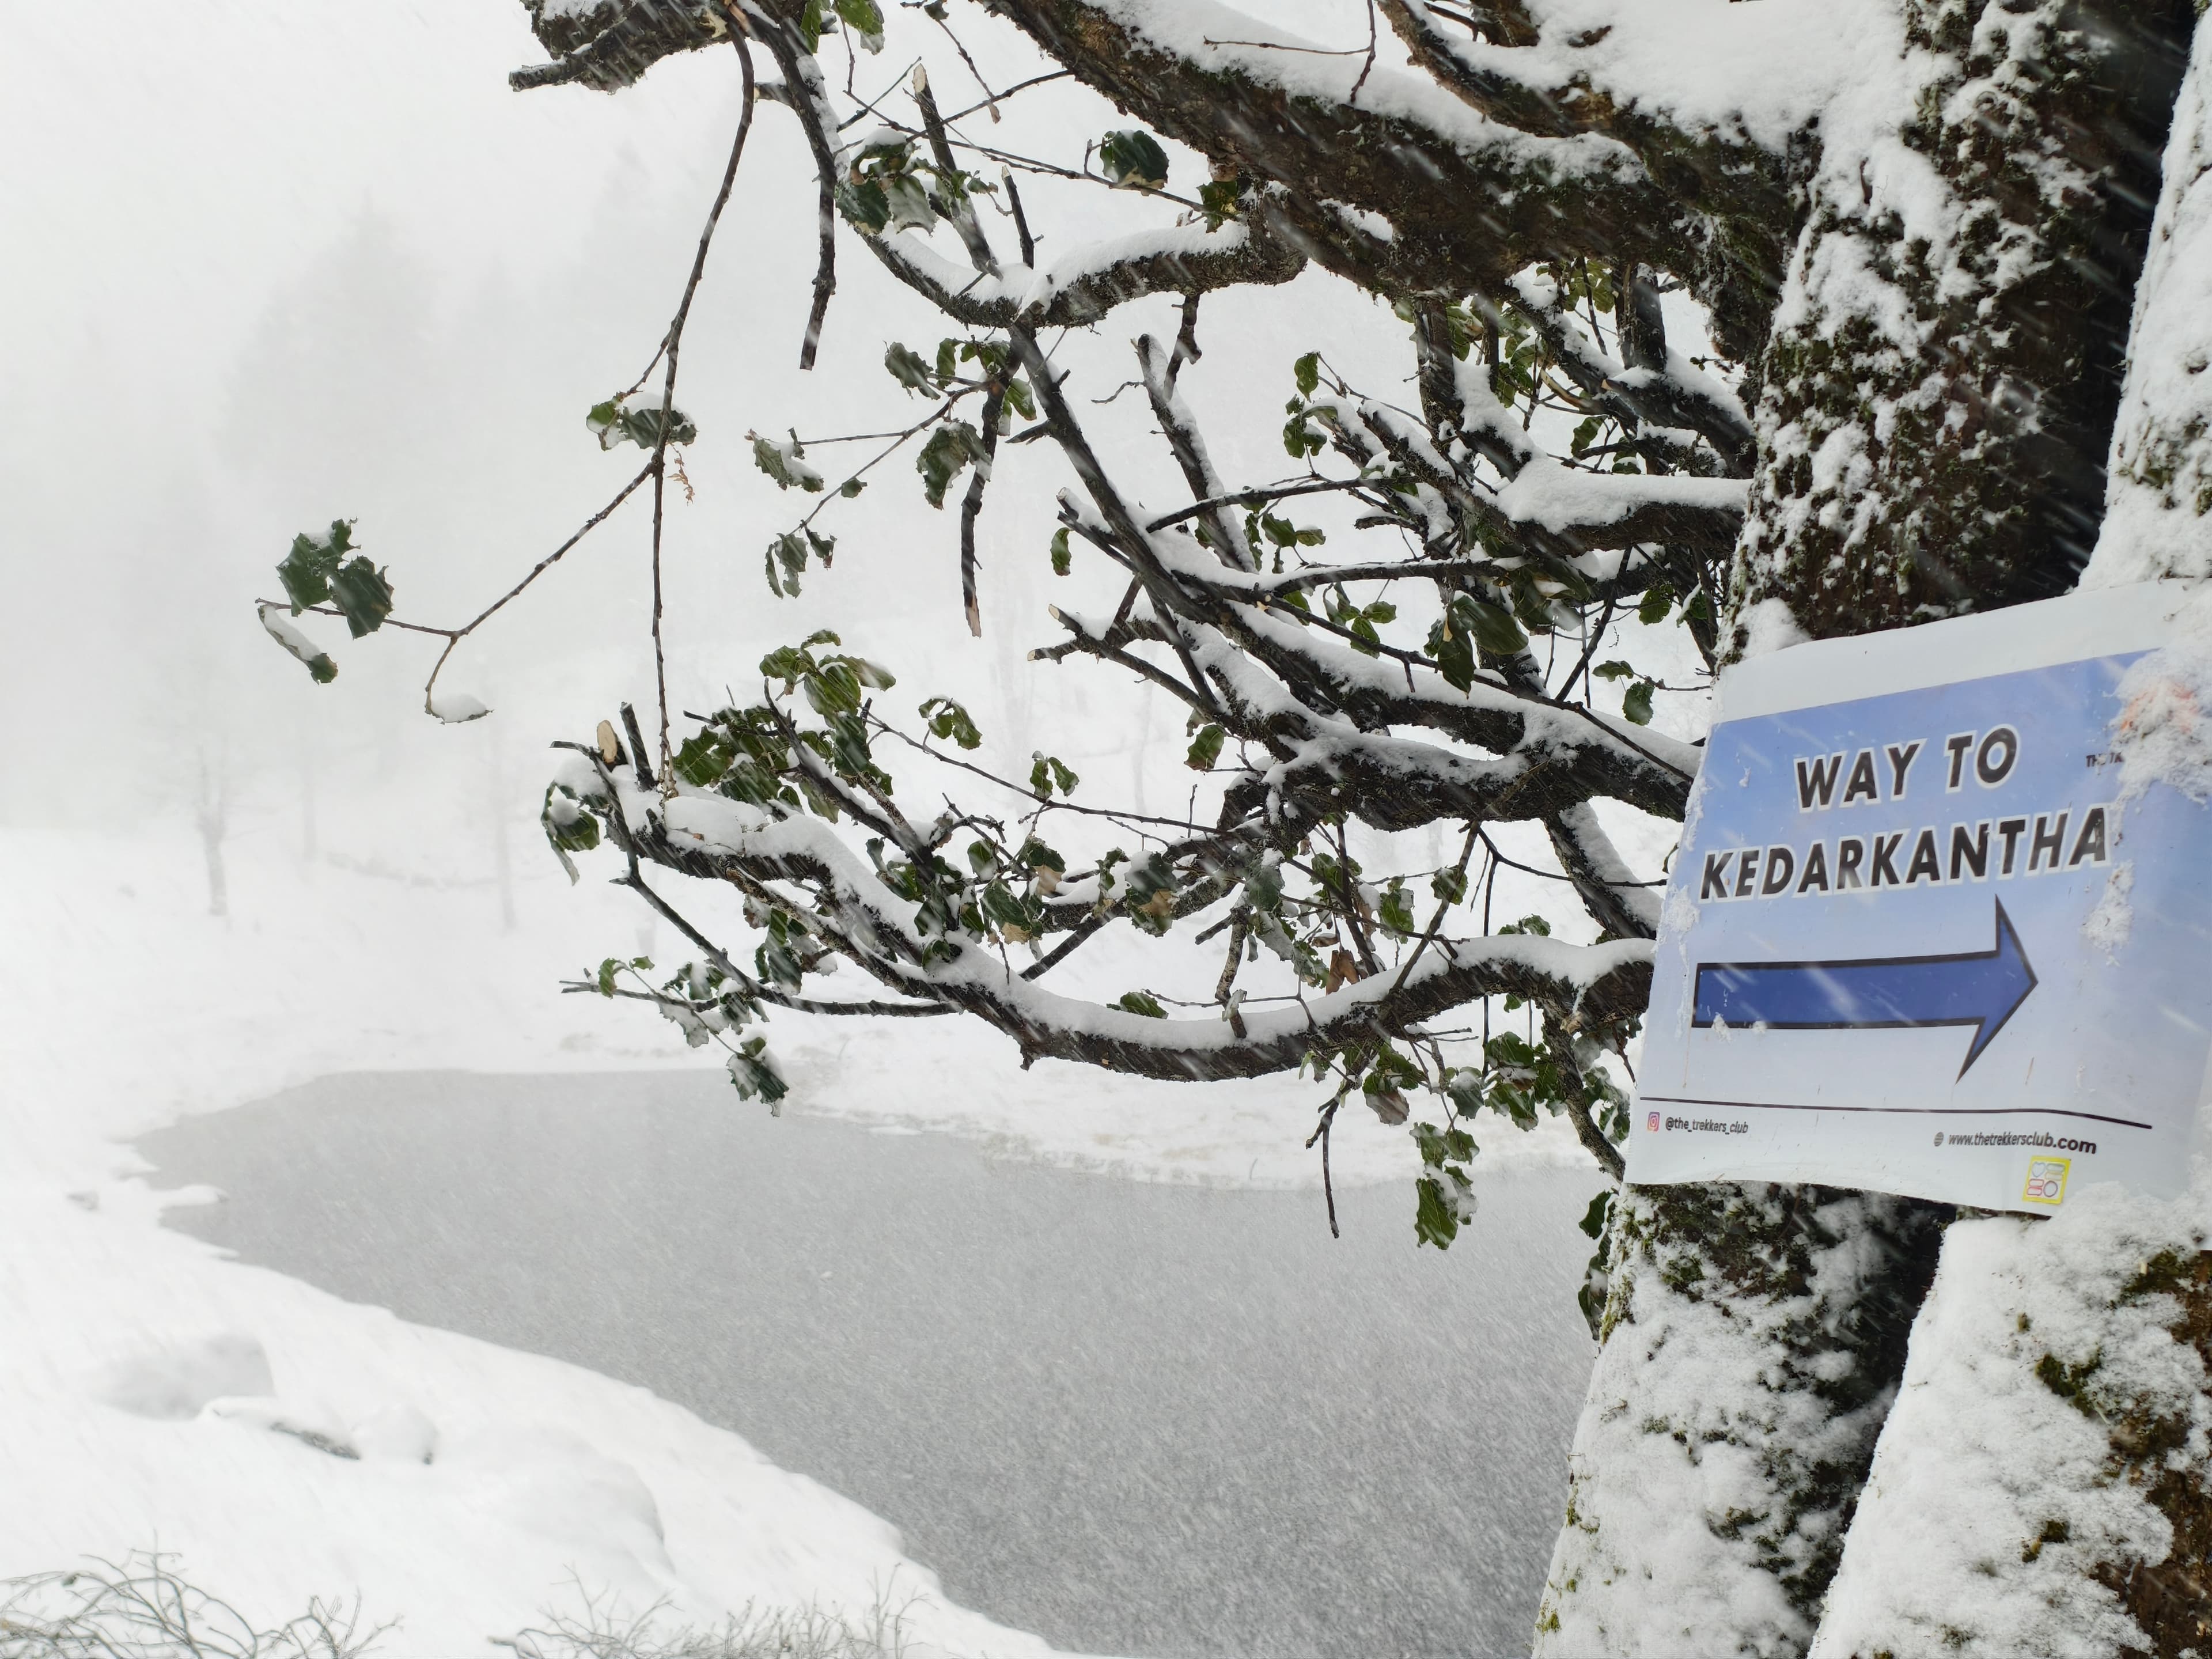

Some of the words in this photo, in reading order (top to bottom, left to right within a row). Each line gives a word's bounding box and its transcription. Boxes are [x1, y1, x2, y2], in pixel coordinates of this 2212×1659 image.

[1795, 741, 1923, 810] WAY
[1946, 726, 2018, 787] TO
[1699, 806, 2108, 901] KEDARKANTHA
[1665, 1116, 1749, 1135] @the_trekkers_club
[1948, 1131, 2097, 1154] www.thetrekkersclub.com
